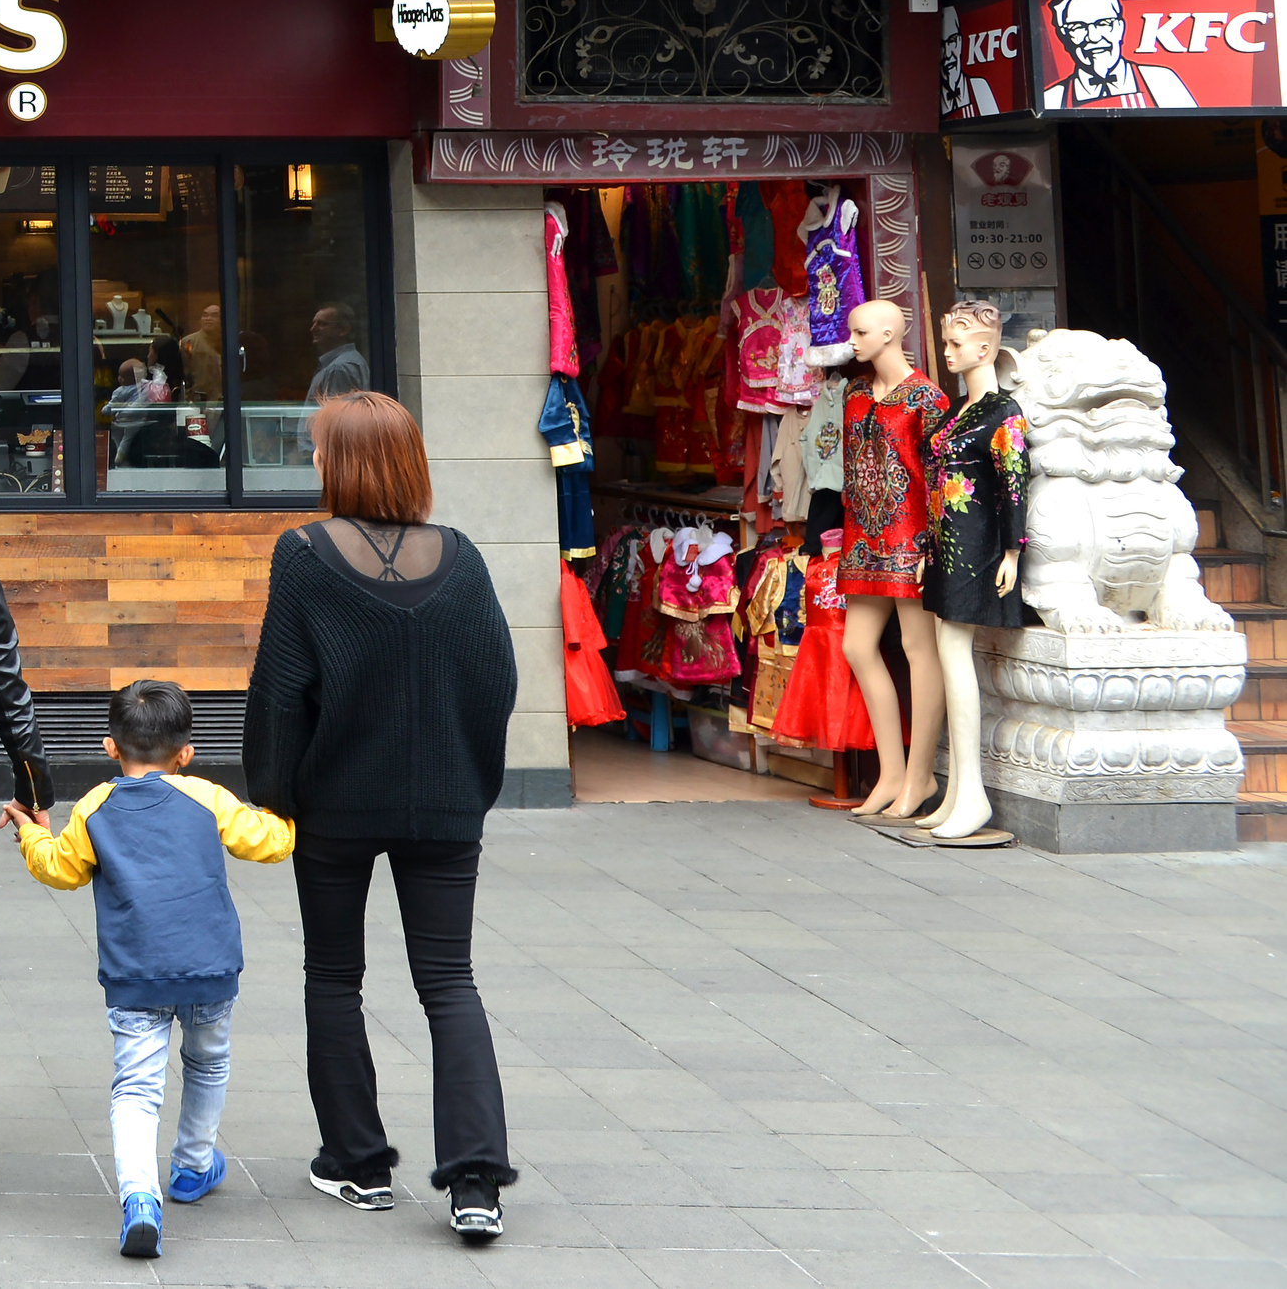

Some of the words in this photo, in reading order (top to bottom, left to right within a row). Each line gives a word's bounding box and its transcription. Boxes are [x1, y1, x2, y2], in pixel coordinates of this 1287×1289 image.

[397, 2, 444, 29] Häagen-Dazs
[1134, 11, 1269, 53] KFC
[966, 24, 1019, 66] KFC
[592, 136, 749, 172] 玲珑轩
[971, 234, 1042, 243] 09:30-21:00
